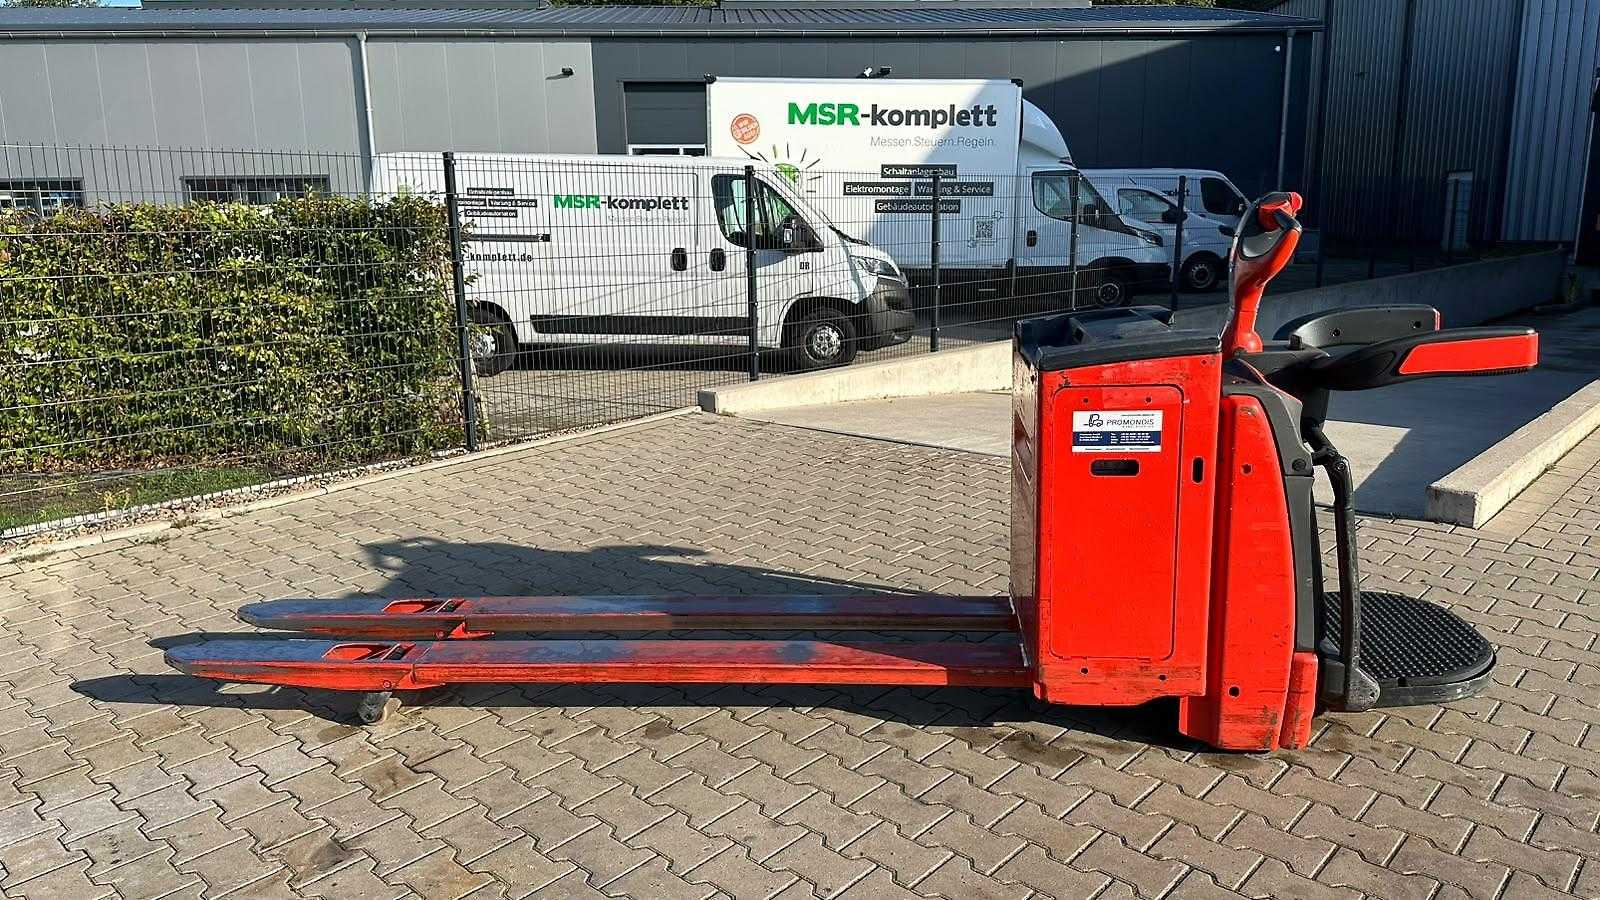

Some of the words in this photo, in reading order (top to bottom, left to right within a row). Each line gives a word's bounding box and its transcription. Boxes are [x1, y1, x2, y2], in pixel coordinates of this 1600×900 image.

[788, 102, 997, 129] MSR-komplett
[845, 184, 909, 194] Elektromontage
[917, 184, 952, 195] Warng
[953, 185, 960, 193] &
[962, 185, 991, 193] Service
[553, 194, 689, 211] MSR-komplett
[876, 201, 960, 211] Gebäudeautoation
